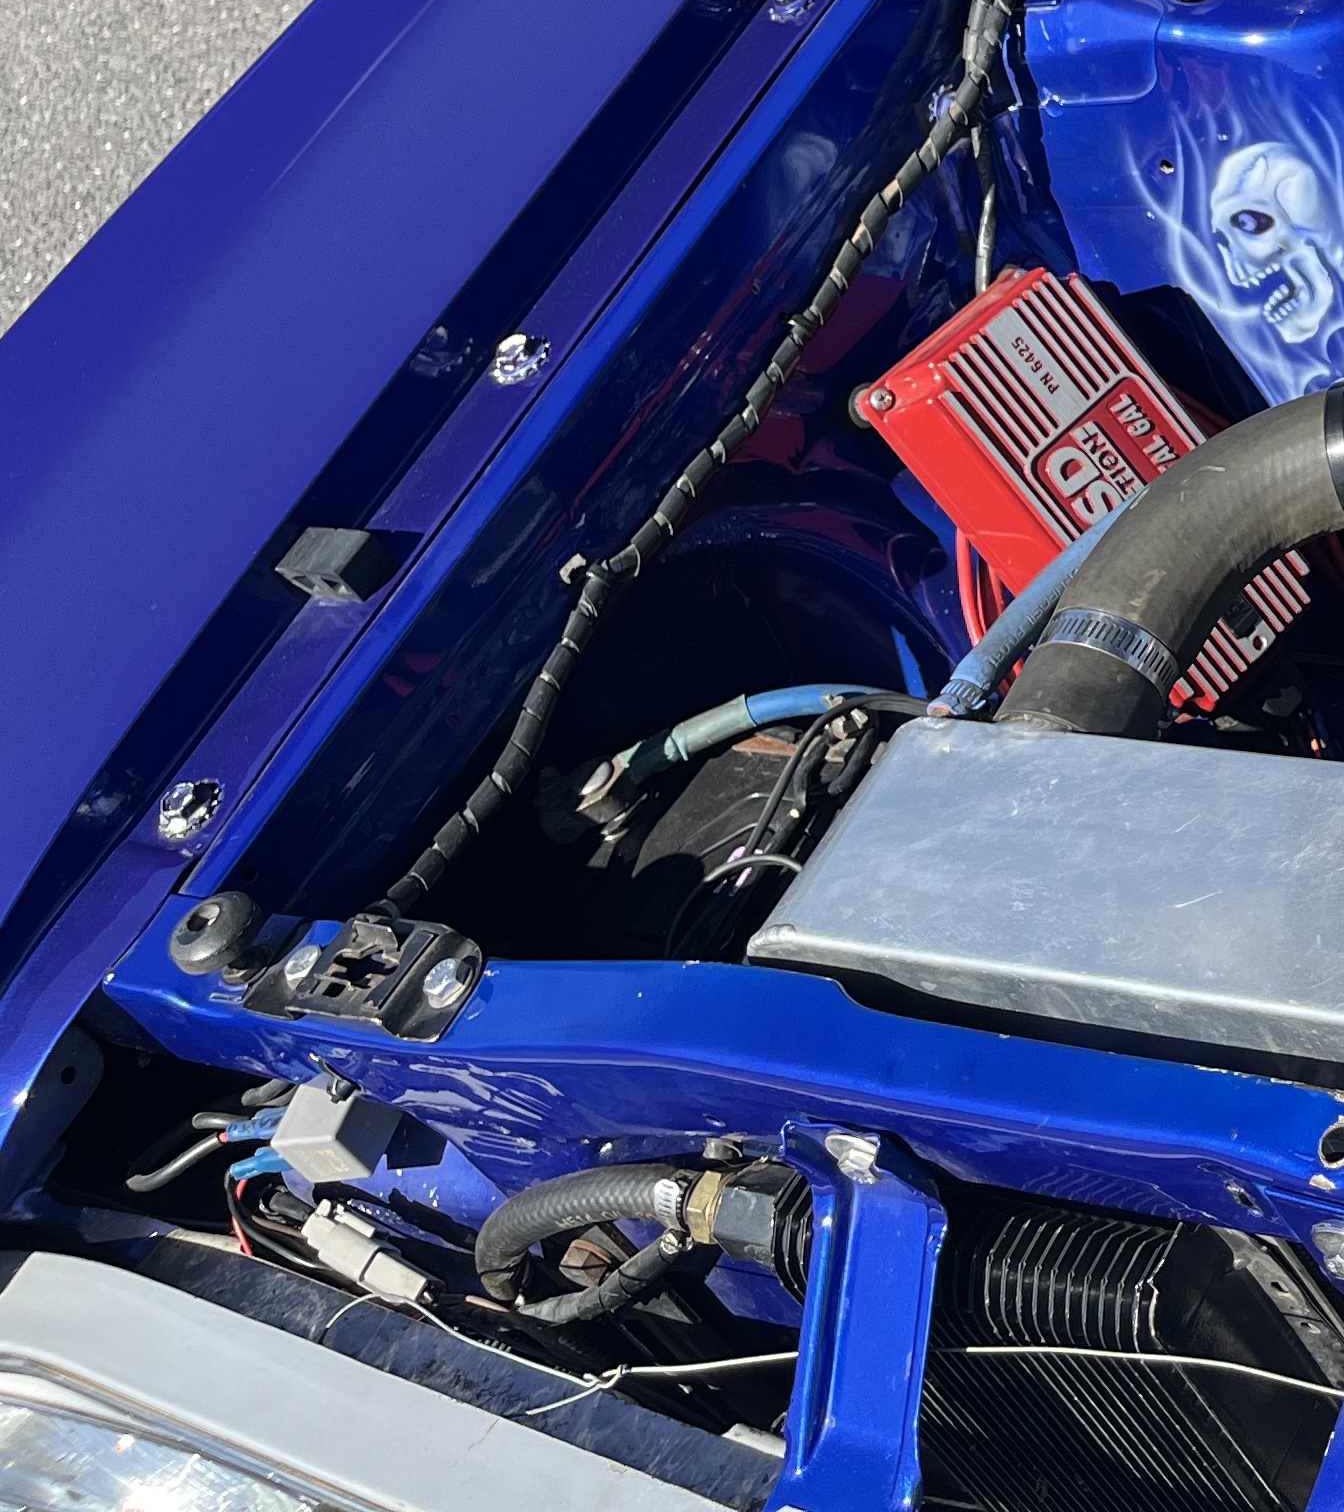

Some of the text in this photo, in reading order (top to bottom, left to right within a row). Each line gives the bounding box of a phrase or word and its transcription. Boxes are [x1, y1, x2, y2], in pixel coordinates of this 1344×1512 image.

[1011, 336, 1061, 395] PN 6425
[1046, 447, 1122, 526] SD
